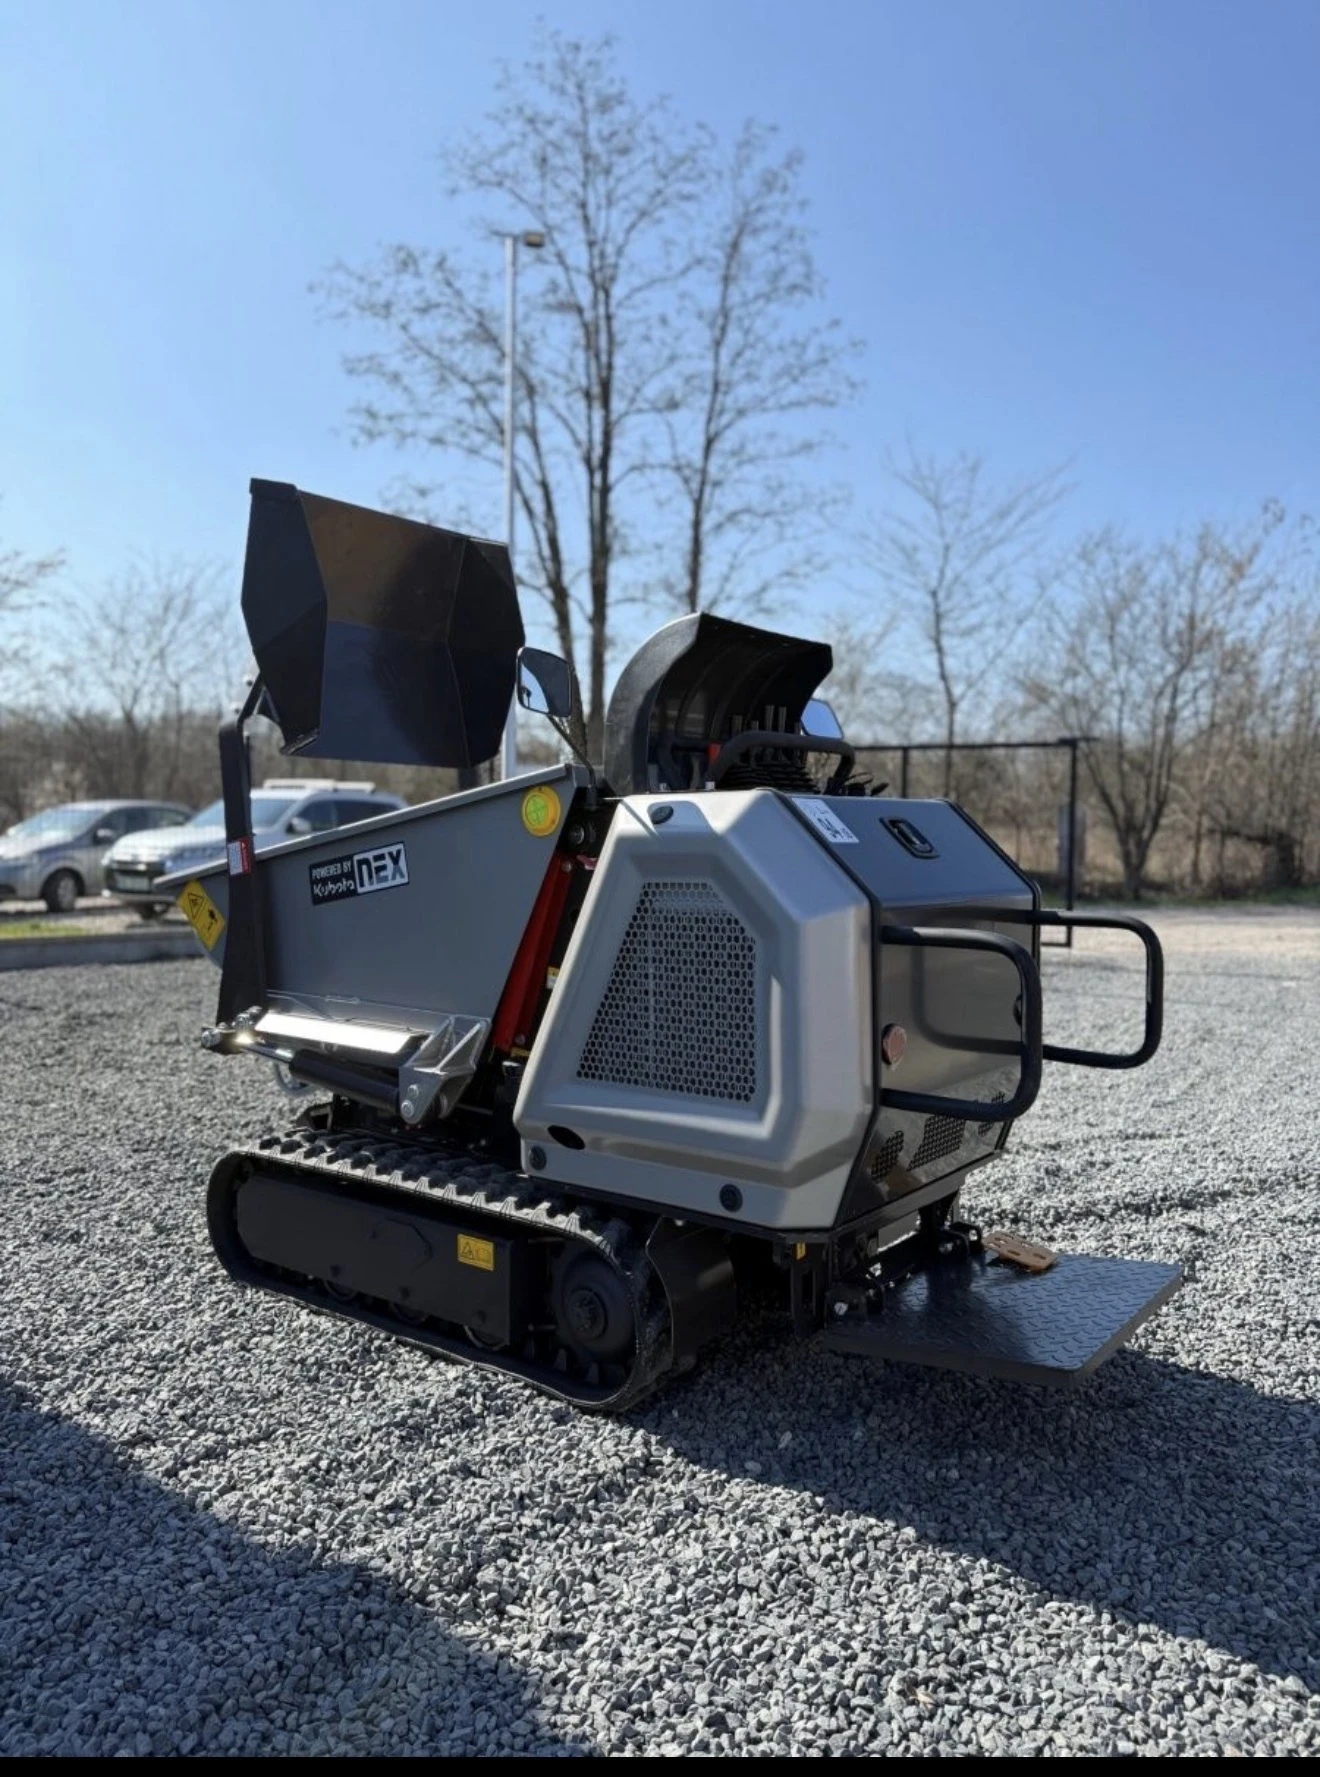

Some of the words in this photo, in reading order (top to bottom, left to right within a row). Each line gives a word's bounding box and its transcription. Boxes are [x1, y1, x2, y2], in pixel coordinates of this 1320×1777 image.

[312, 863, 342, 879] POWERED
[342, 860, 352, 873] BY
[313, 878, 355, 897] Kubota
